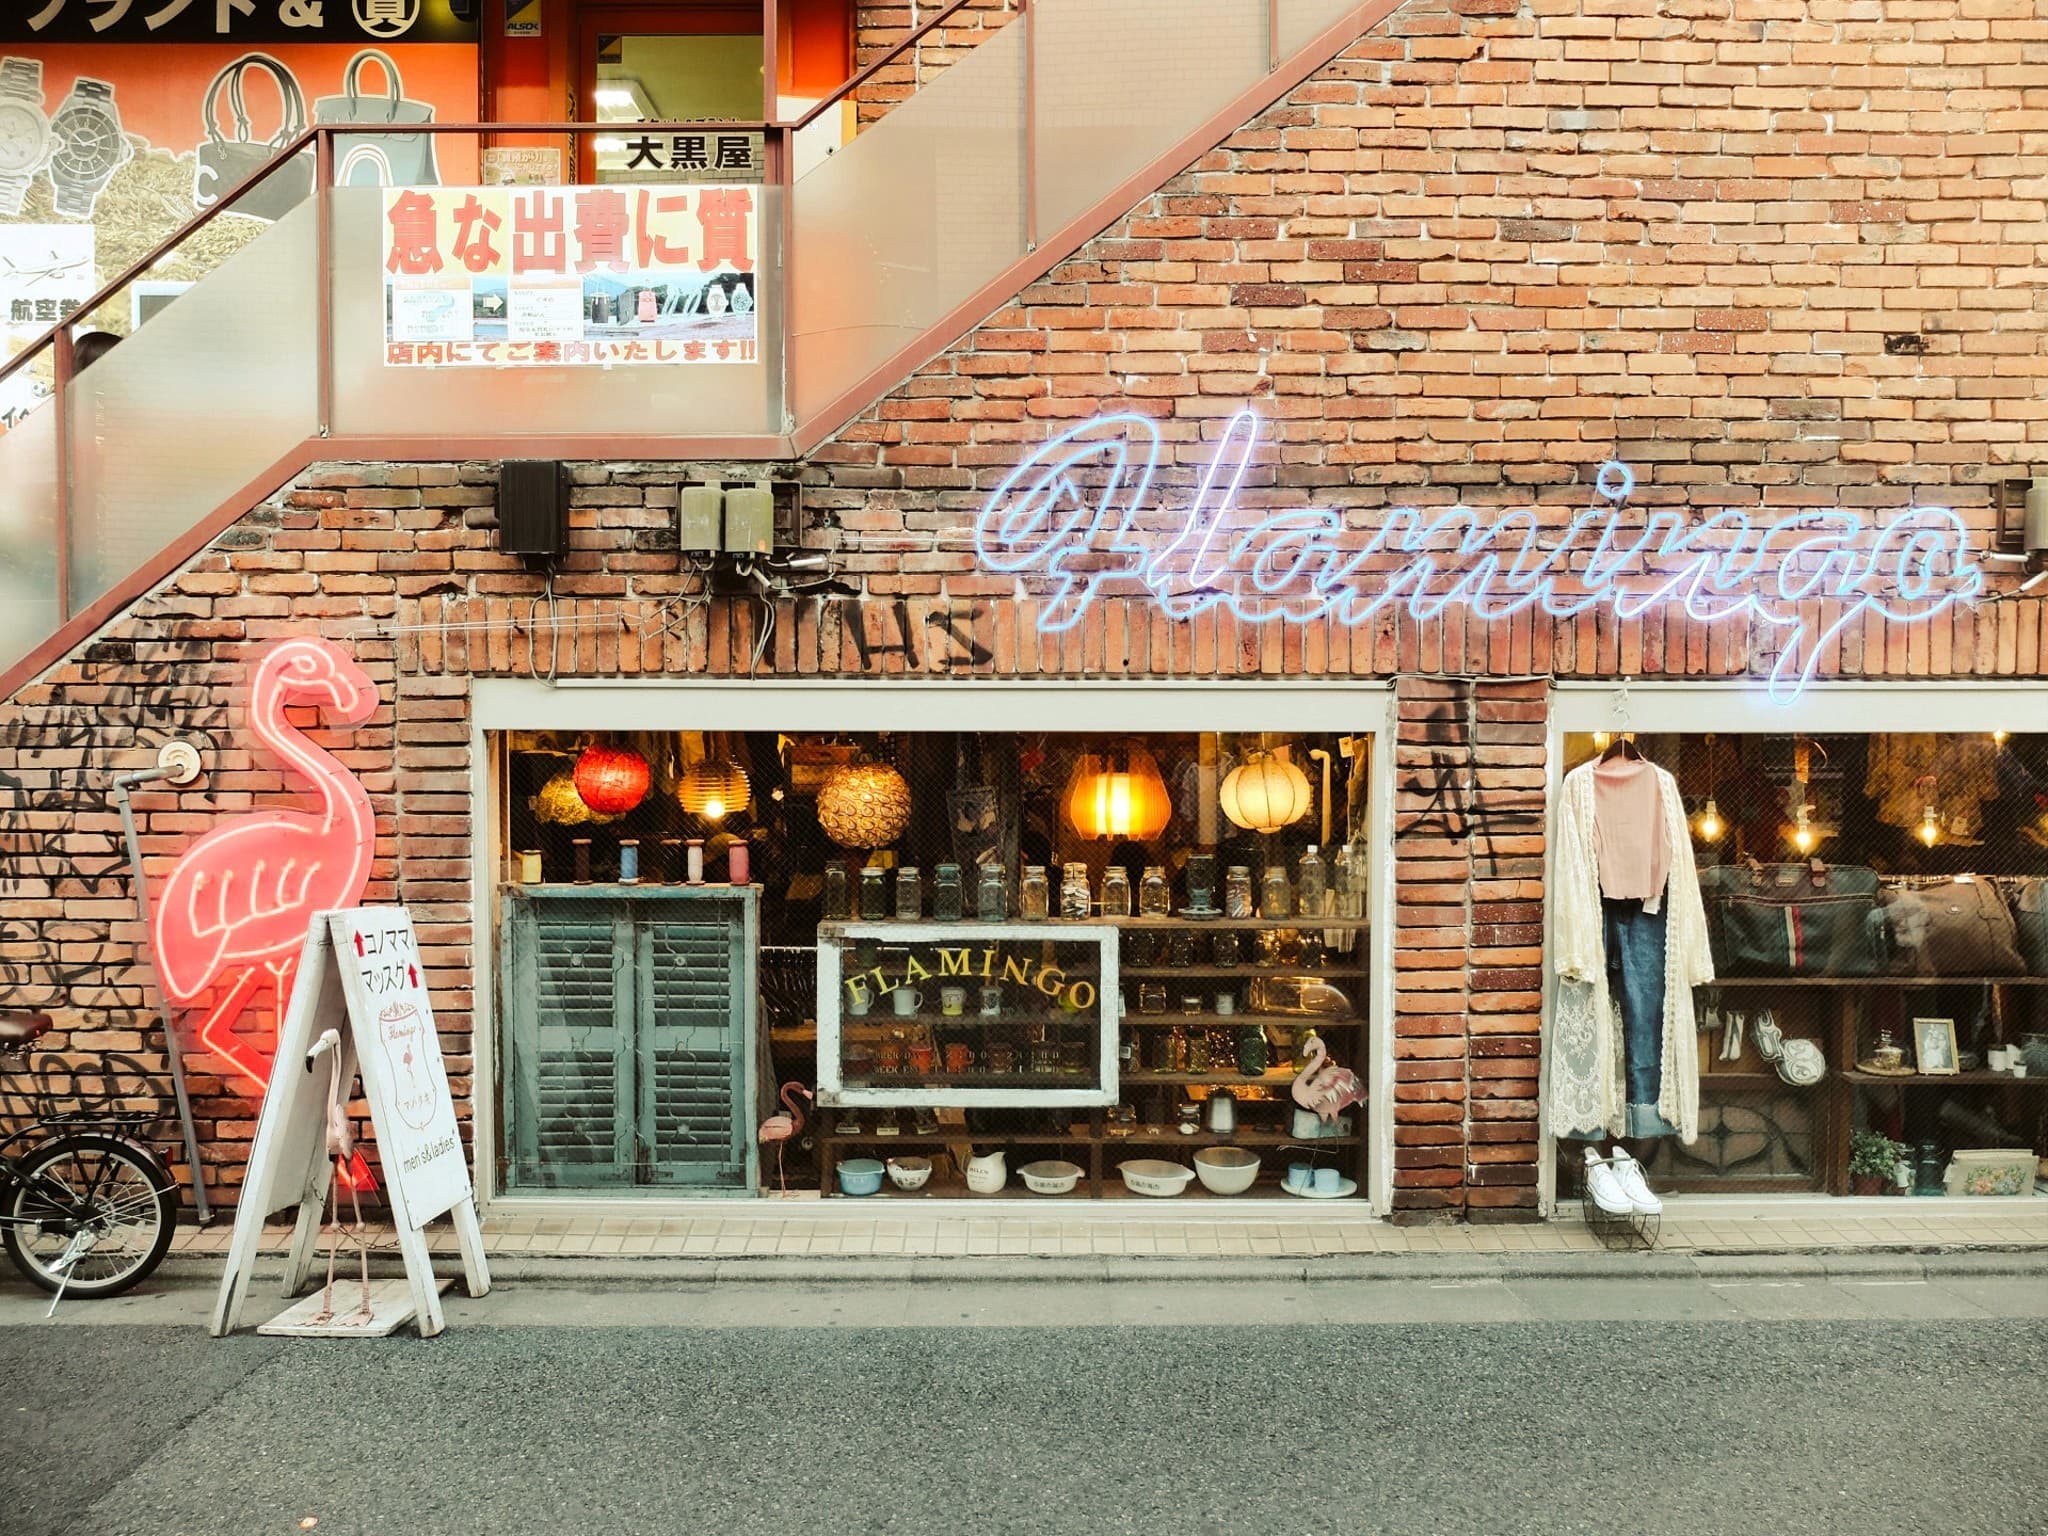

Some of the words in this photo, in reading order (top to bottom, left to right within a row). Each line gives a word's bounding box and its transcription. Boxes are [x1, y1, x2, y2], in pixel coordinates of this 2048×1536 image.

[626, 136, 752, 169] 大黒屋
[386, 188, 754, 274] 急な出費に質
[975, 410, 1982, 706] Flamingo
[844, 948, 1096, 1009] FLAMINGO
